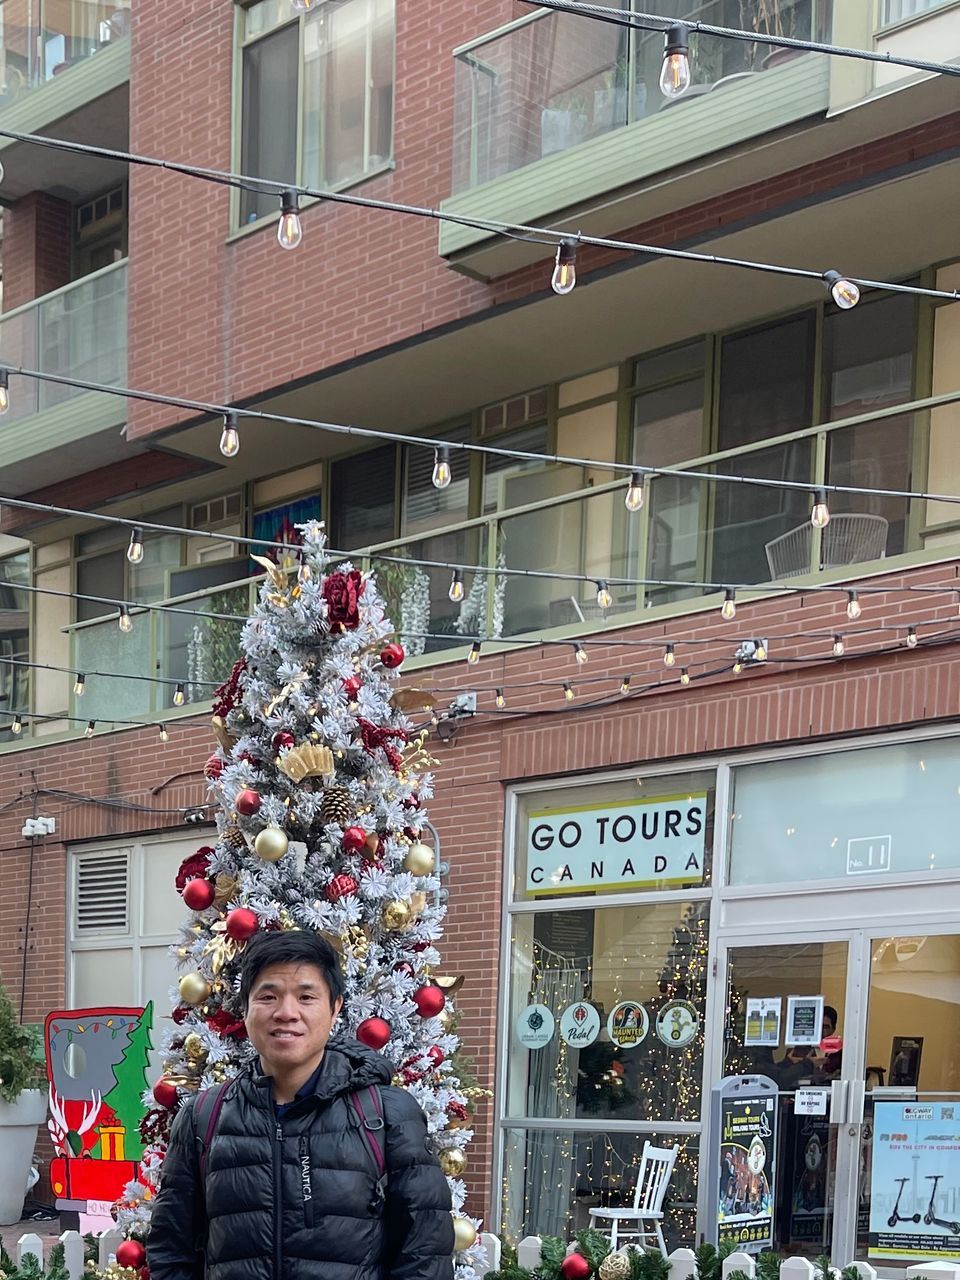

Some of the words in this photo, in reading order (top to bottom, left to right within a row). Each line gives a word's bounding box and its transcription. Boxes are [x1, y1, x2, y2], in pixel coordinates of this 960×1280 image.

[531, 820, 582, 851] GO
[596, 807, 702, 844] TOURS
[530, 852, 699, 883] CANADA
[567, 1025, 595, 1041] Pedal
[613, 1027, 644, 1037] HAUNTED
[301, 1155, 313, 1202] NAUTICA
